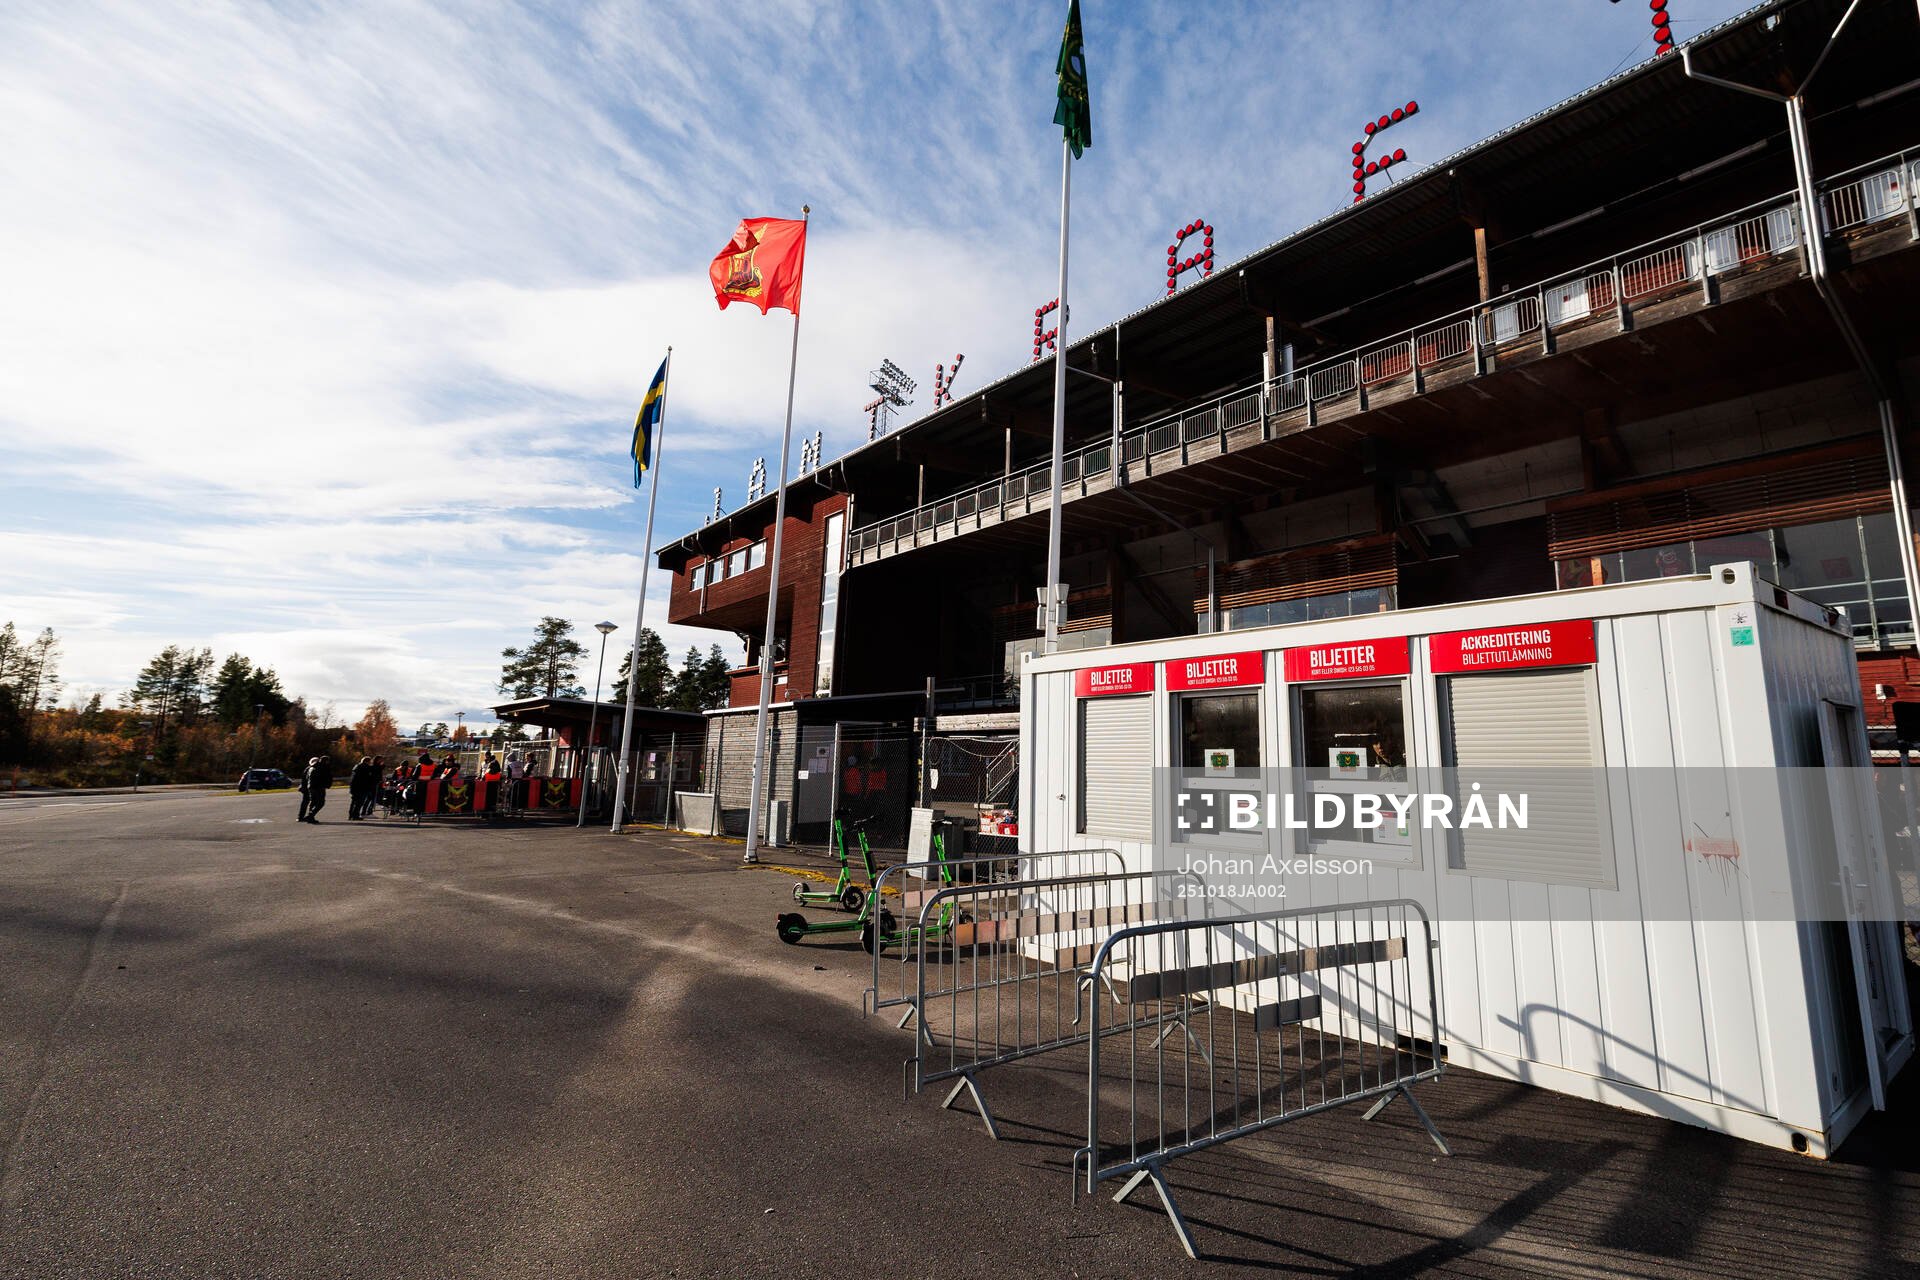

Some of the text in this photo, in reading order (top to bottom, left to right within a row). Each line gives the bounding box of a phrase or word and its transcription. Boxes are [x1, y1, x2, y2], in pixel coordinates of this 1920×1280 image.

[1461, 629, 1551, 651] ACKREDITERING
[1310, 645, 1375, 668] BILJETTER
[1462, 647, 1552, 665] BILJETTUTLÄMNING
[1091, 668, 1132, 685] BILJETTER
[1186, 658, 1237, 678] BILJETTER
